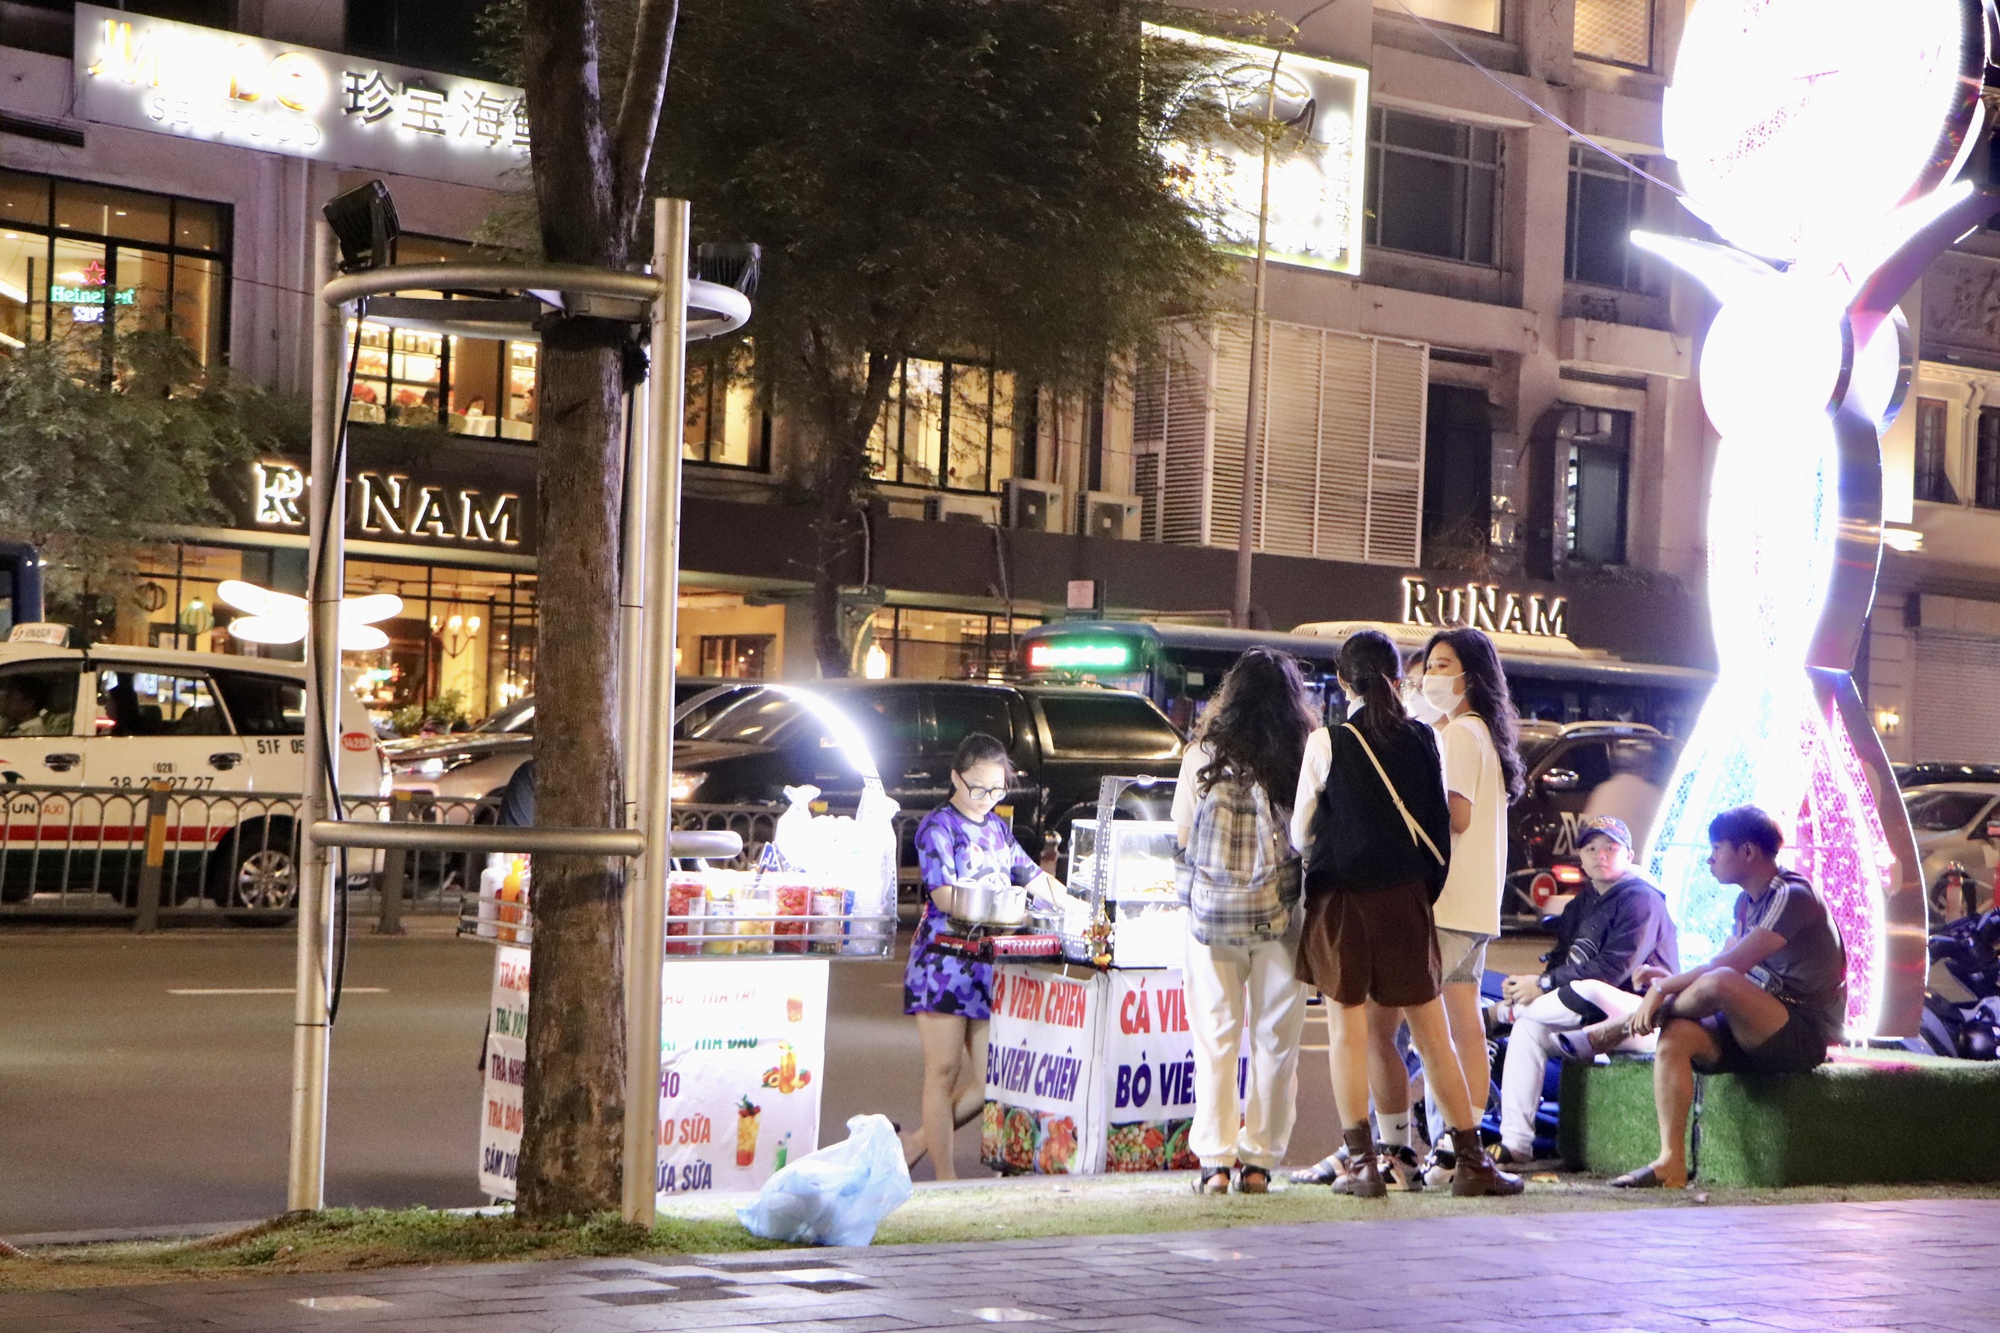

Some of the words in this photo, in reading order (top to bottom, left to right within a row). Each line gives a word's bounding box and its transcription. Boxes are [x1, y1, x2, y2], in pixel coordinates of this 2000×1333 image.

[51, 285, 135, 304] Heineen
[254, 459, 520, 544] RNAM
[257, 739, 281, 755] 51F
[1120, 976, 1151, 1035] CÁ
[1034, 1045, 1082, 1102] CHIÊN
